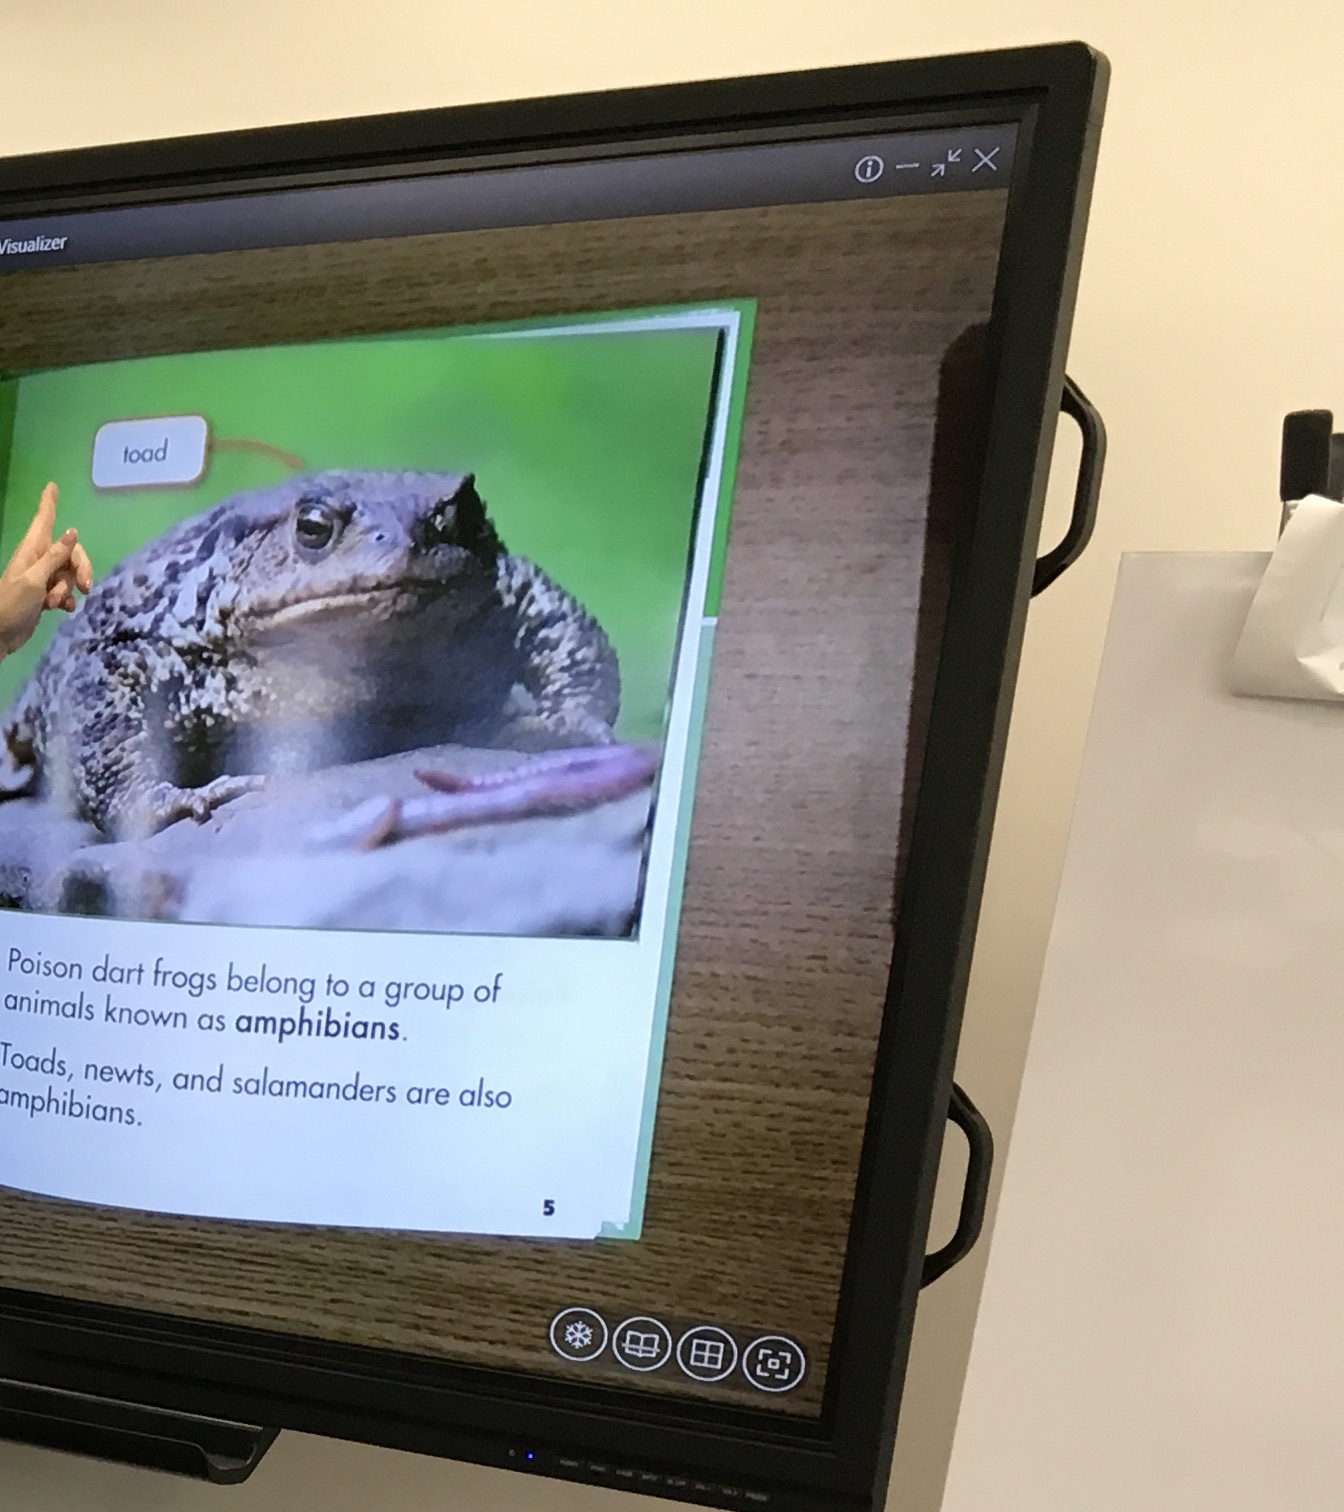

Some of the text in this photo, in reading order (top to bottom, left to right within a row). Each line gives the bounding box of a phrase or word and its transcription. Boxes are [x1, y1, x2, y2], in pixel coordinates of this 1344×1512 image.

[123, 437, 169, 464] toad
[8, 947, 504, 1010] Poison dart frogs belong to a group of
[3, 989, 407, 1044] animals known as amphibians.
[0, 1041, 513, 1109] Toads, newts, and salamanders are also
[542, 1199, 556, 1217] 5
